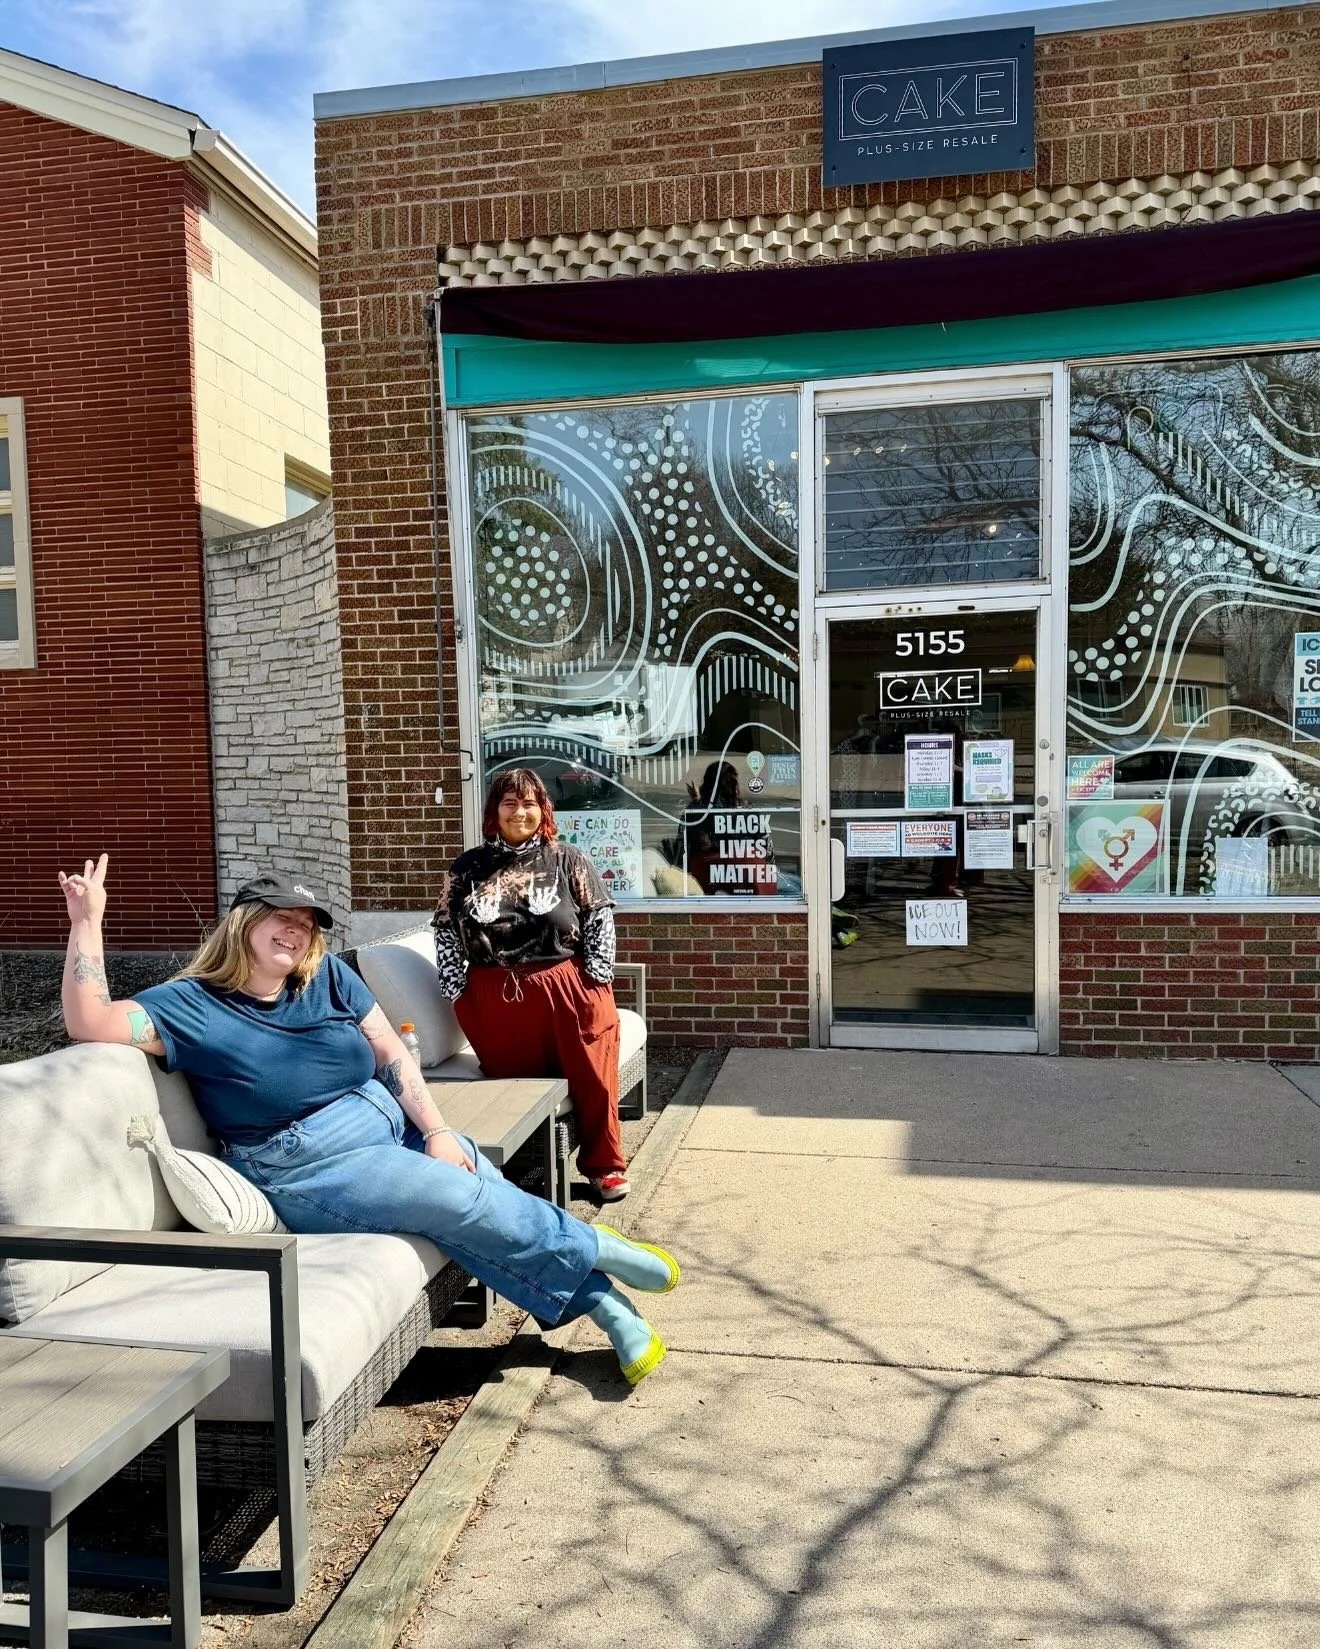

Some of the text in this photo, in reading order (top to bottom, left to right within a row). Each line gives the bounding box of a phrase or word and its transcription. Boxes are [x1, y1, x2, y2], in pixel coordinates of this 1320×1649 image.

[851, 71, 1005, 125] CAKE
[857, 134, 998, 156] PLUS-SIZE RESALE
[895, 630, 966, 656] 5155
[1302, 638, 1320, 652] IC
[887, 675, 975, 702] CAKE
[890, 709, 971, 719] PLUS-SIZE RESALE
[1300, 709, 1318, 717] TELL
[1297, 717, 1320, 725] STAN
[1072, 760, 1111, 769] ALL ARE
[1071, 769, 1111, 777] WELCOME
[1071, 777, 1099, 786] HERE
[564, 818, 629, 830] WE CAN DO
[714, 814, 772, 834] BLACK
[905, 824, 952, 833] EVERYONE
[590, 846, 618, 857] CARE
[720, 839, 767, 859] LIVES
[709, 863, 778, 883] MATTER
[909, 901, 962, 919] ICE OUT
[915, 920, 960, 940] NOW!
